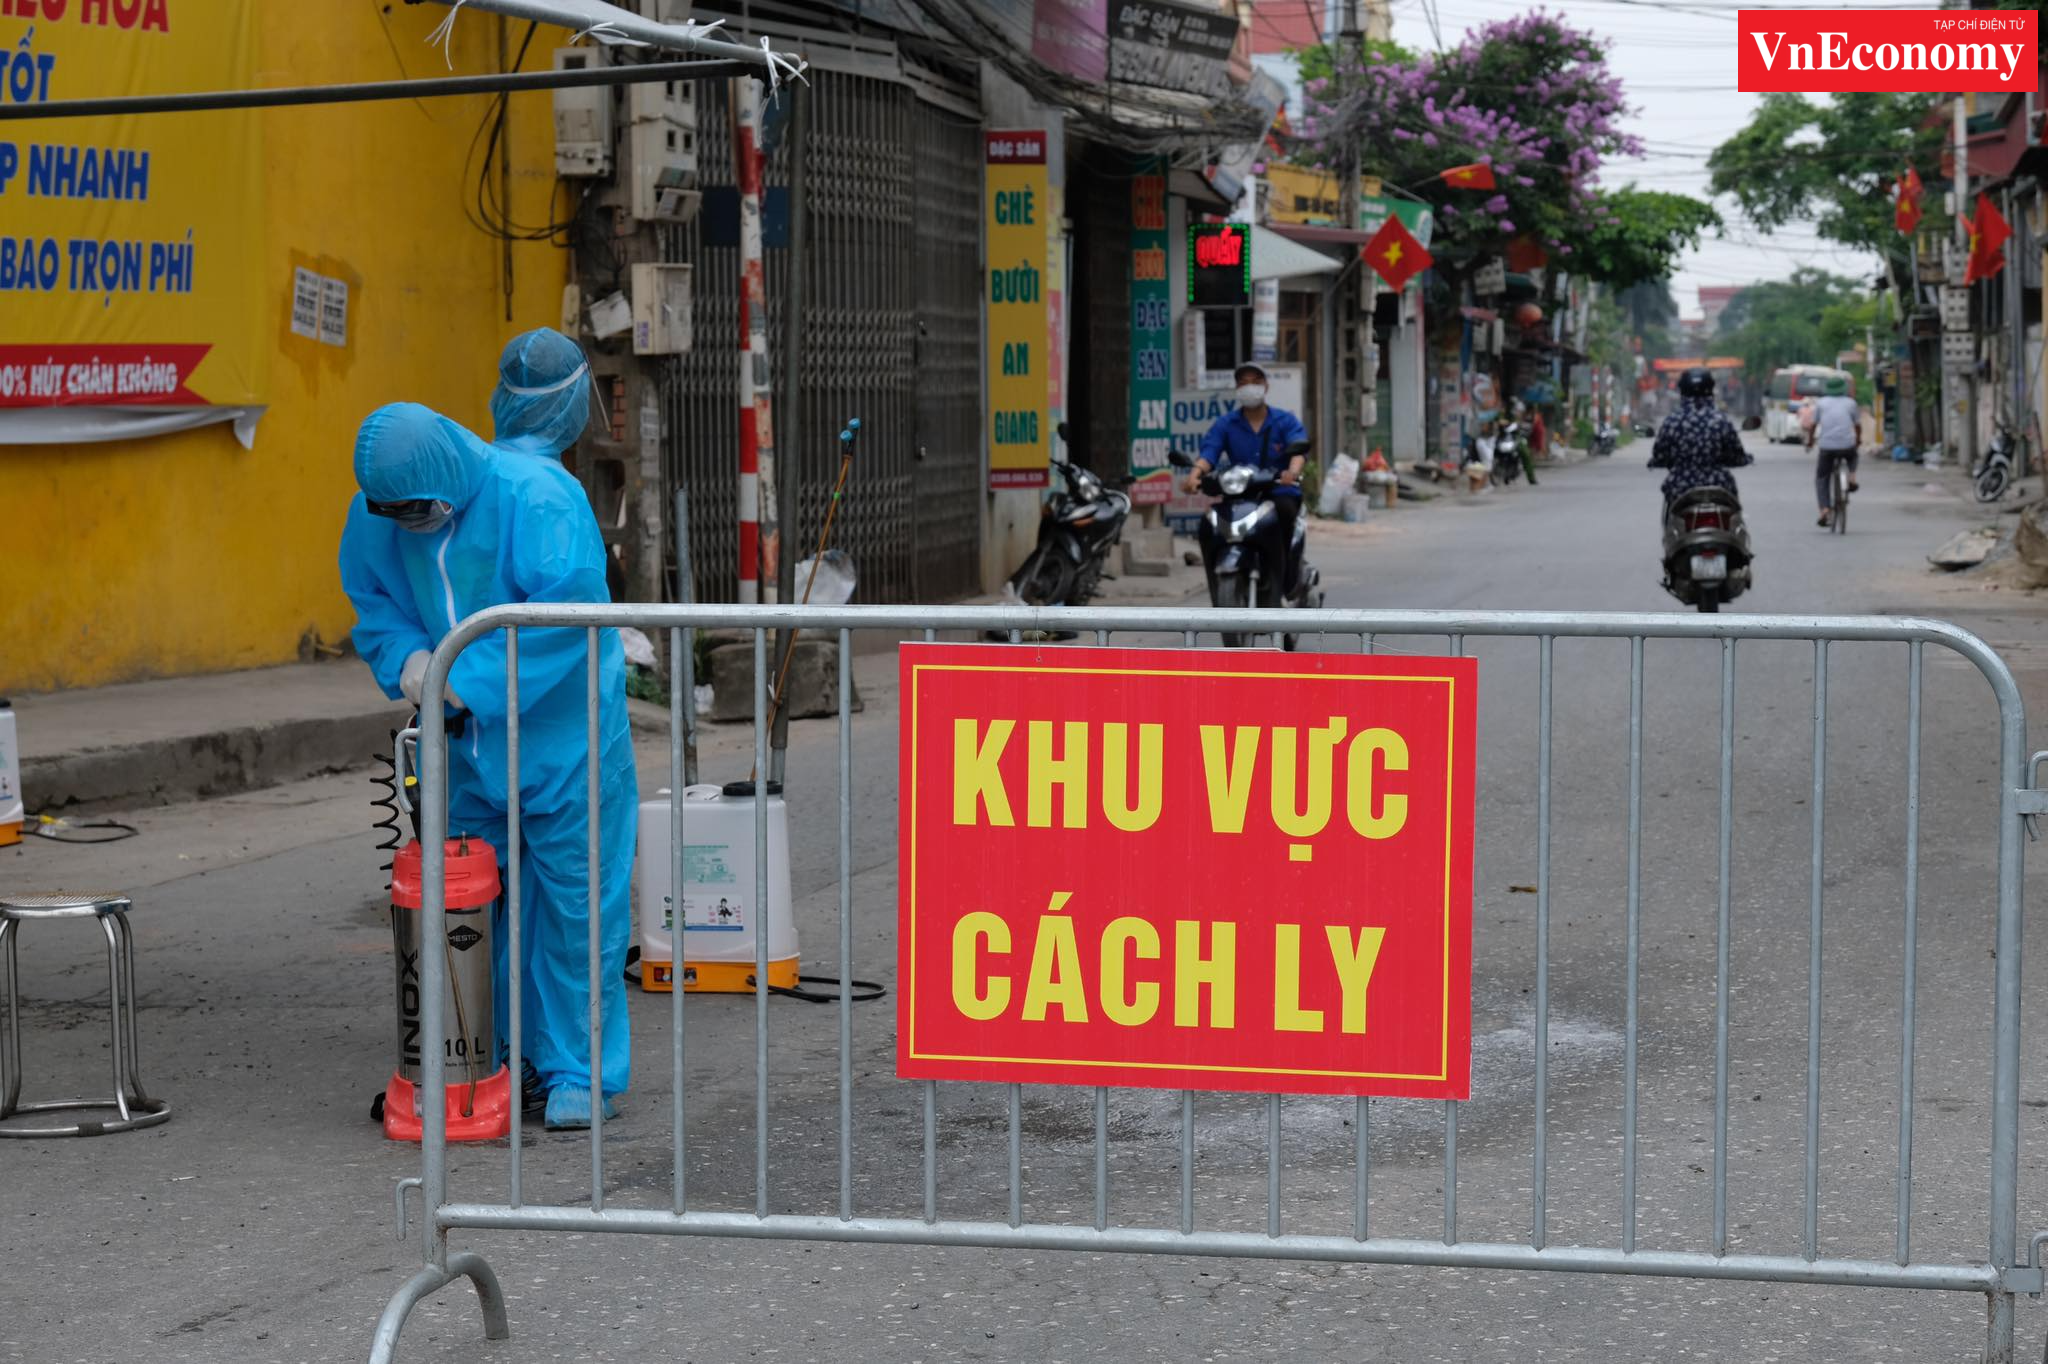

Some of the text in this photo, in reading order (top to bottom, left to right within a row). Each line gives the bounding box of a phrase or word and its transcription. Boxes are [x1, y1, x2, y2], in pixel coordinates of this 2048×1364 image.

[27, 144, 149, 201] NHANH
[0, 227, 194, 307] BAO TRỌN PHÍ
[30, 356, 64, 397] HÚT
[66, 355, 115, 395] CHÂN
[117, 355, 178, 394] KHÔNG
[1003, 342, 1029, 376] AN
[994, 411, 1038, 445] GIANG
[1137, 400, 1167, 430] AN
[952, 716, 1409, 861] KHU VỰC
[951, 891, 1386, 1034] CÁCH LY
[402, 949, 421, 1067] INOX
[444, 1036, 486, 1057] 10 L
